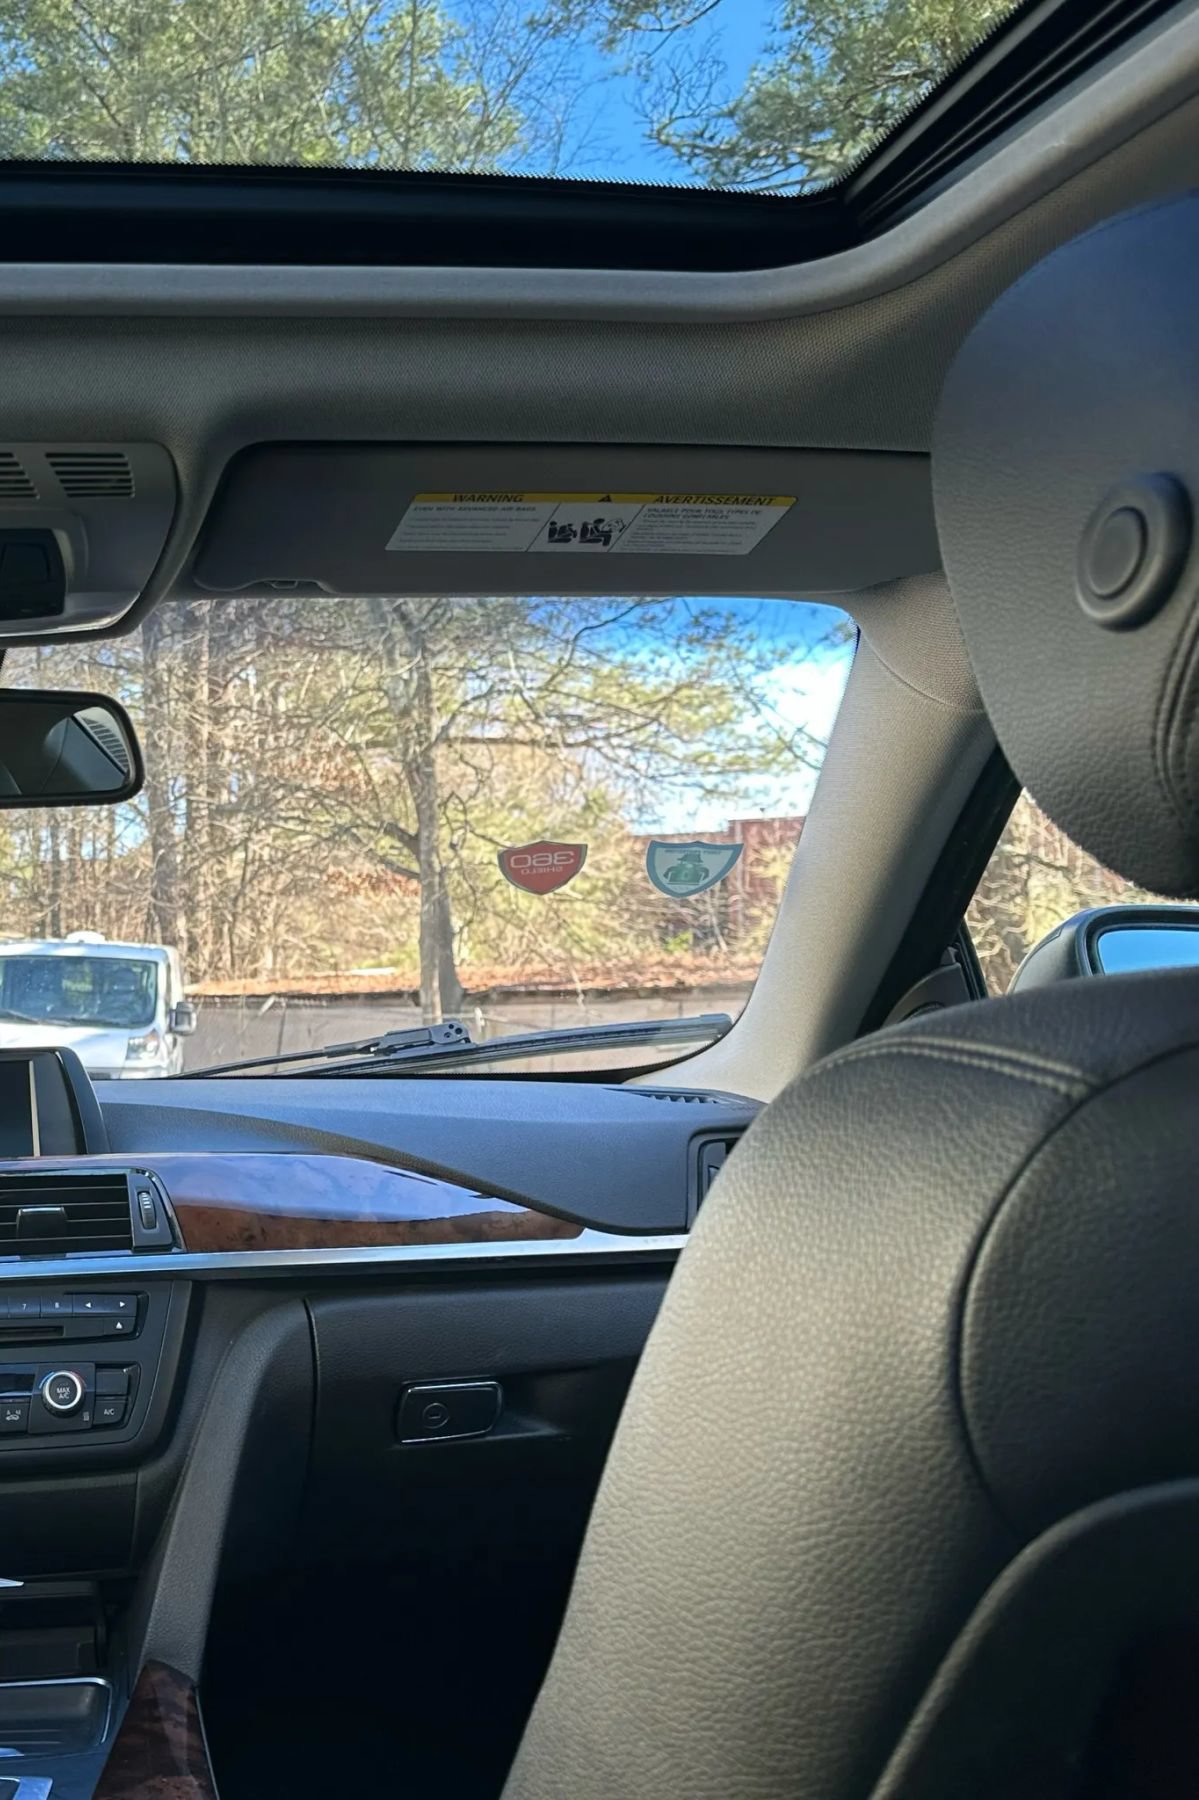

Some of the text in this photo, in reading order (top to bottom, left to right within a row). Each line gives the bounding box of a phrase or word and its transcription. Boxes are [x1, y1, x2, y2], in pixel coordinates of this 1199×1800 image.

[452, 494, 525, 503] WARNING
[654, 495, 776, 506] AVERTISSEMENT
[54, 1301, 60, 1309] 8
[103, 1408, 115, 1416] A/C
